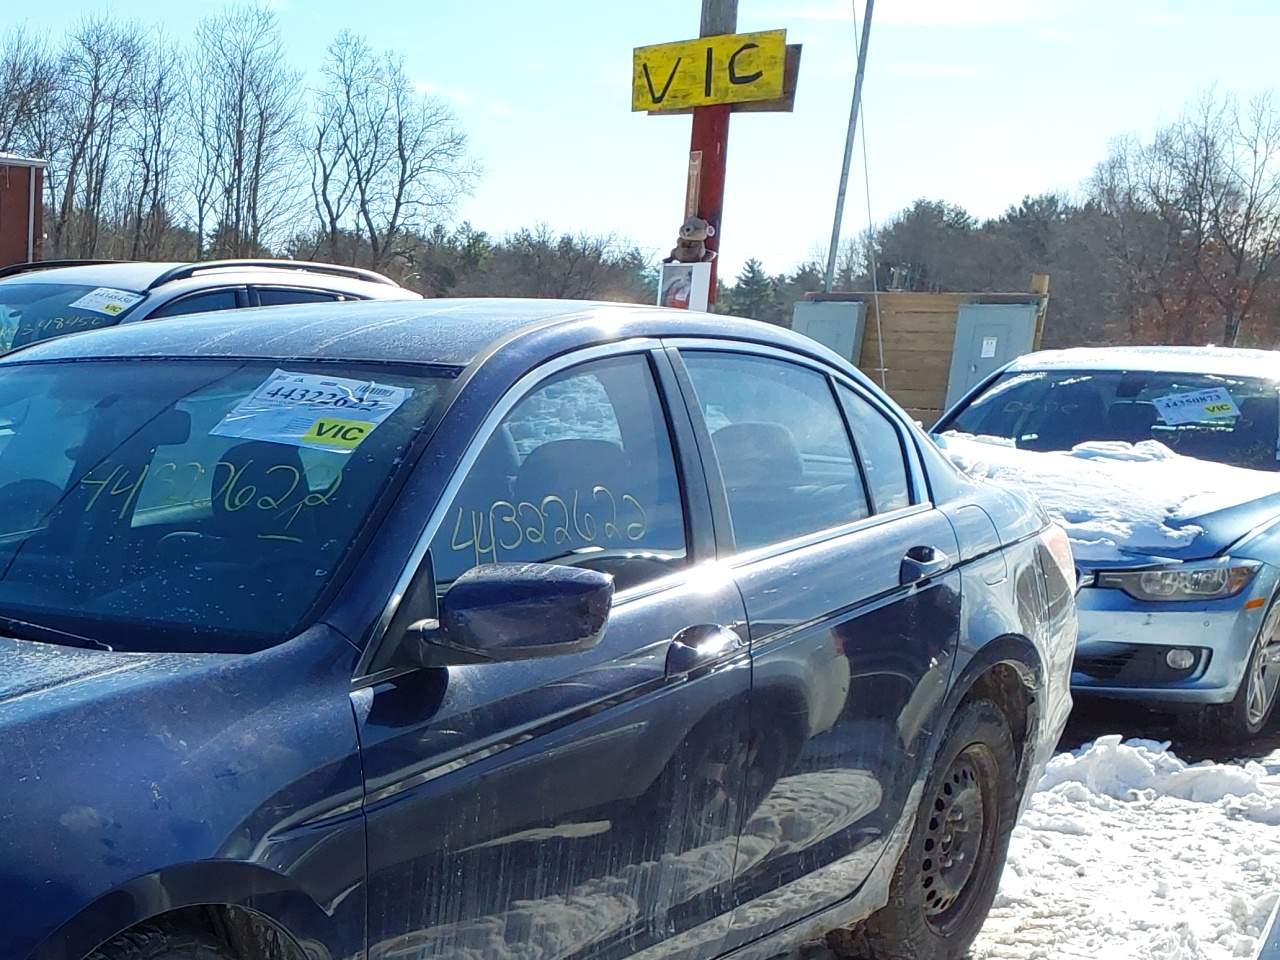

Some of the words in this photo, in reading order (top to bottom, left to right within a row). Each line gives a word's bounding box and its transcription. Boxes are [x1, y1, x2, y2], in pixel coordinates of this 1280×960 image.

[642, 43, 764, 104] VIC
[266, 386, 380, 412] 44322622
[1205, 403, 1231, 413] VIC
[315, 422, 365, 442] VIC
[451, 486, 647, 566] 44322622
